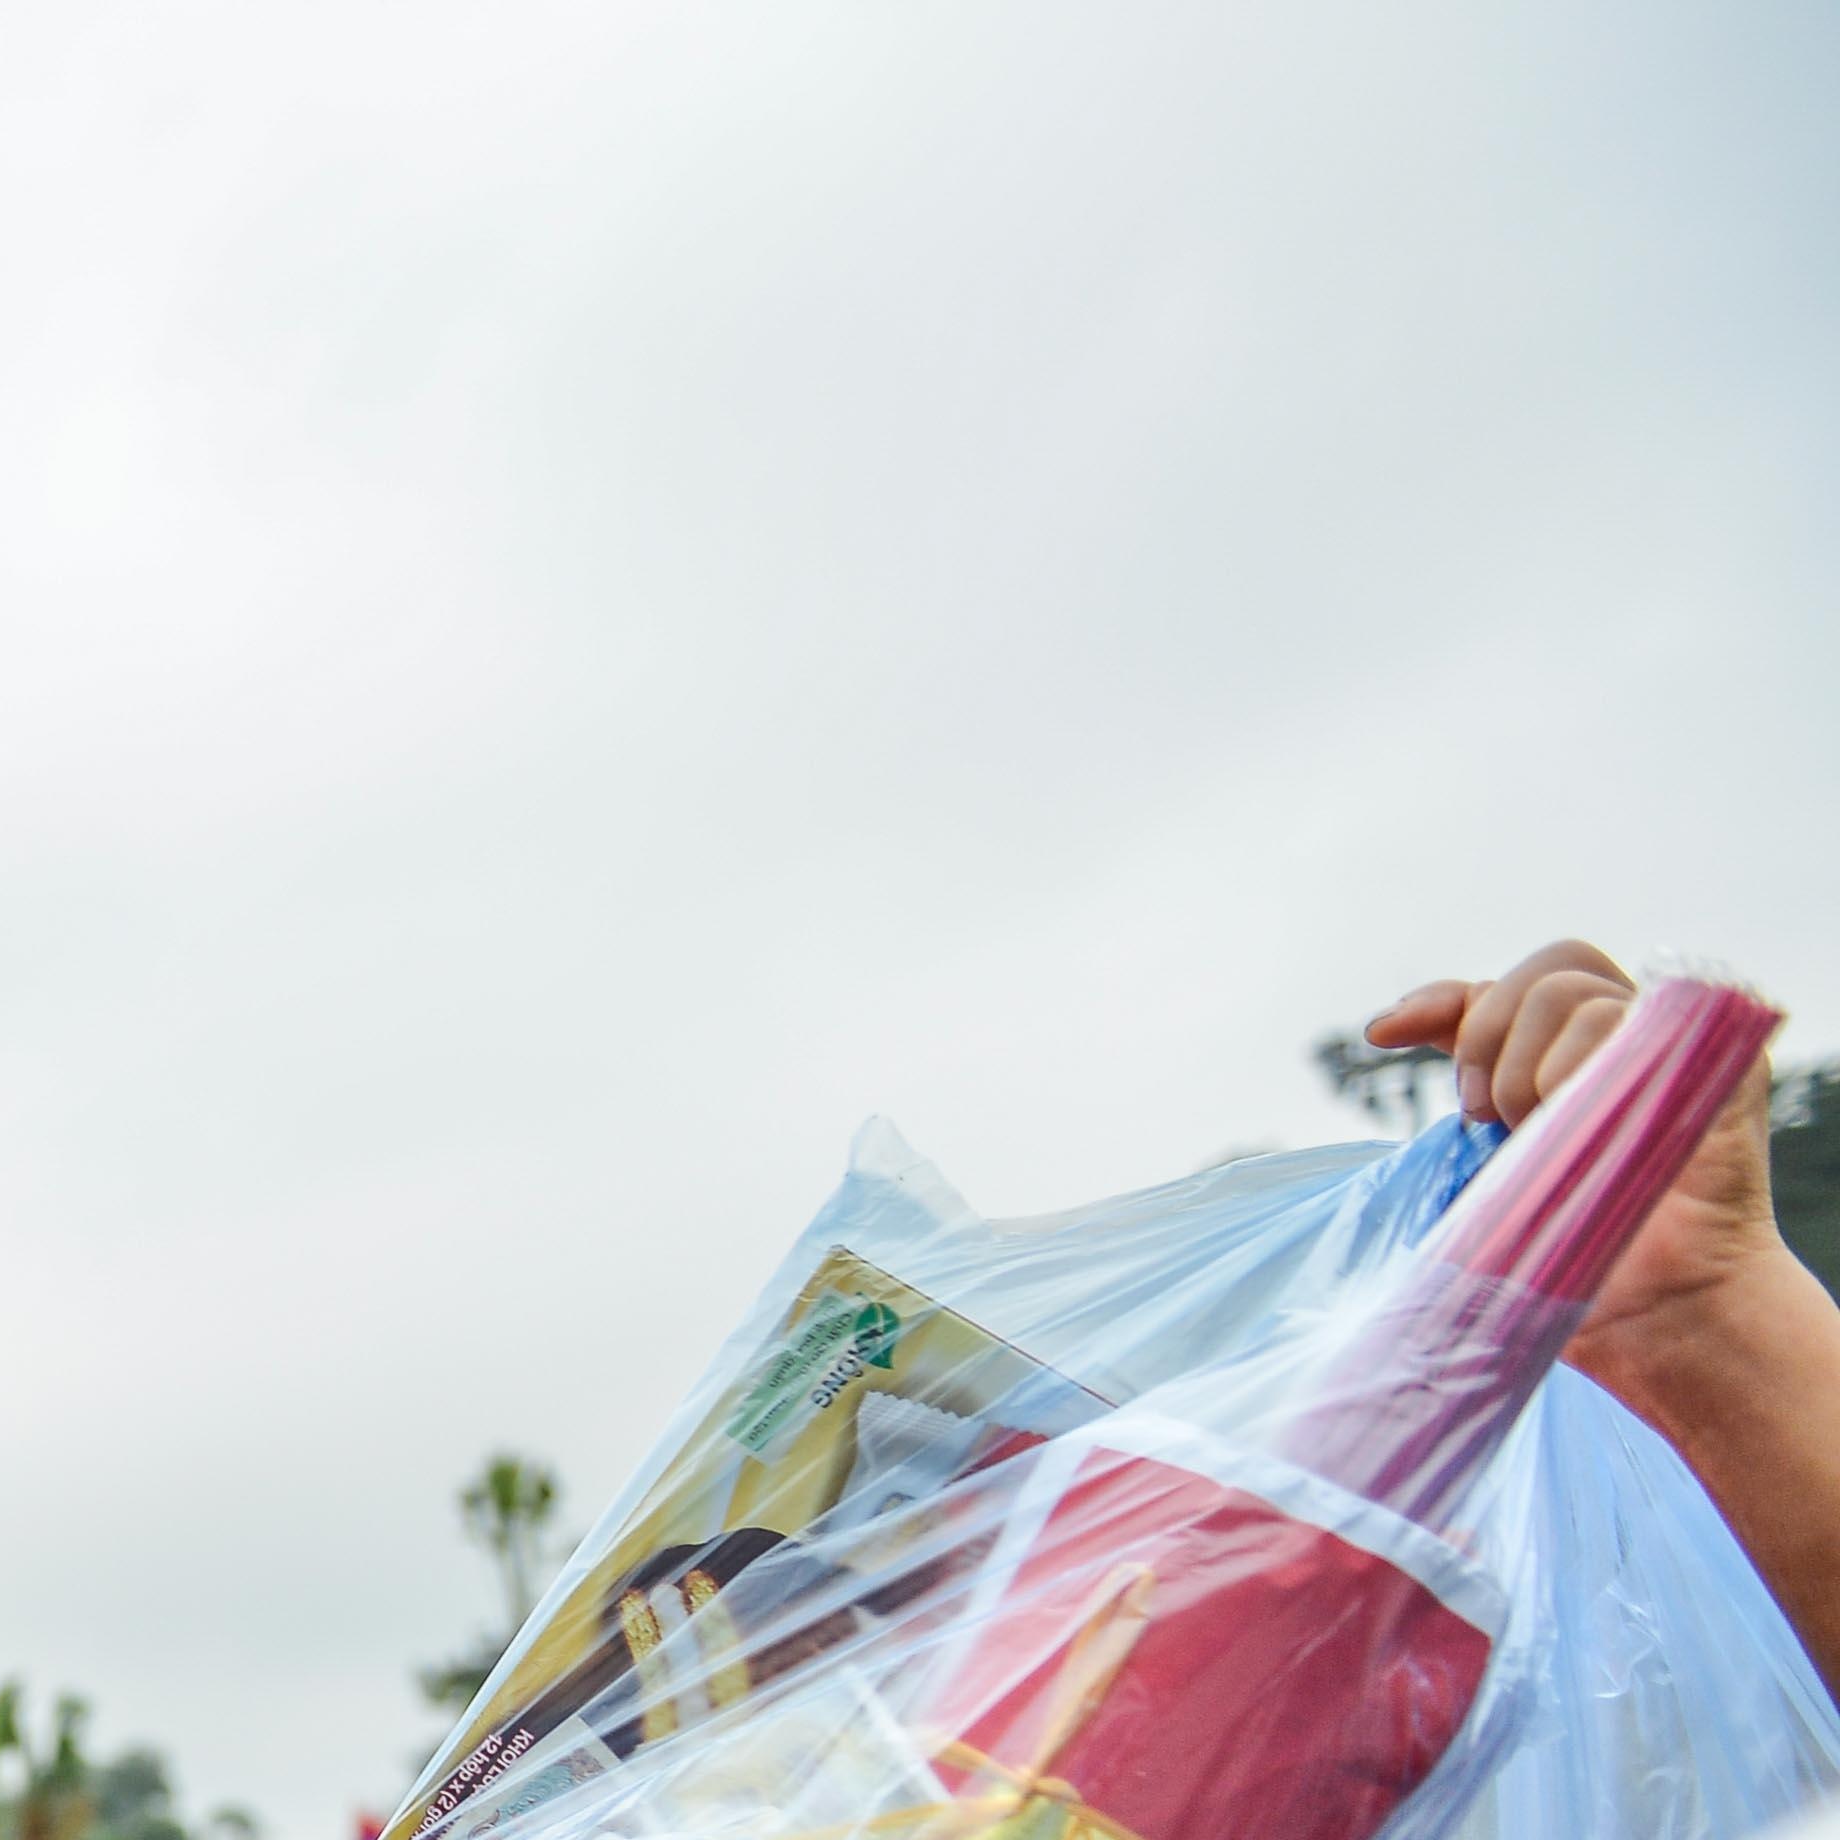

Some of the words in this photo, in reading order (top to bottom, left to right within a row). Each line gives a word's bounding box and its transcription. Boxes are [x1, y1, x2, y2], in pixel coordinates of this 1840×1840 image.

[480, 1733, 503, 1756] 12
[456, 1749, 490, 1783] hộp
[447, 1778, 465, 1795] x
[436, 1791, 459, 1812] (2
